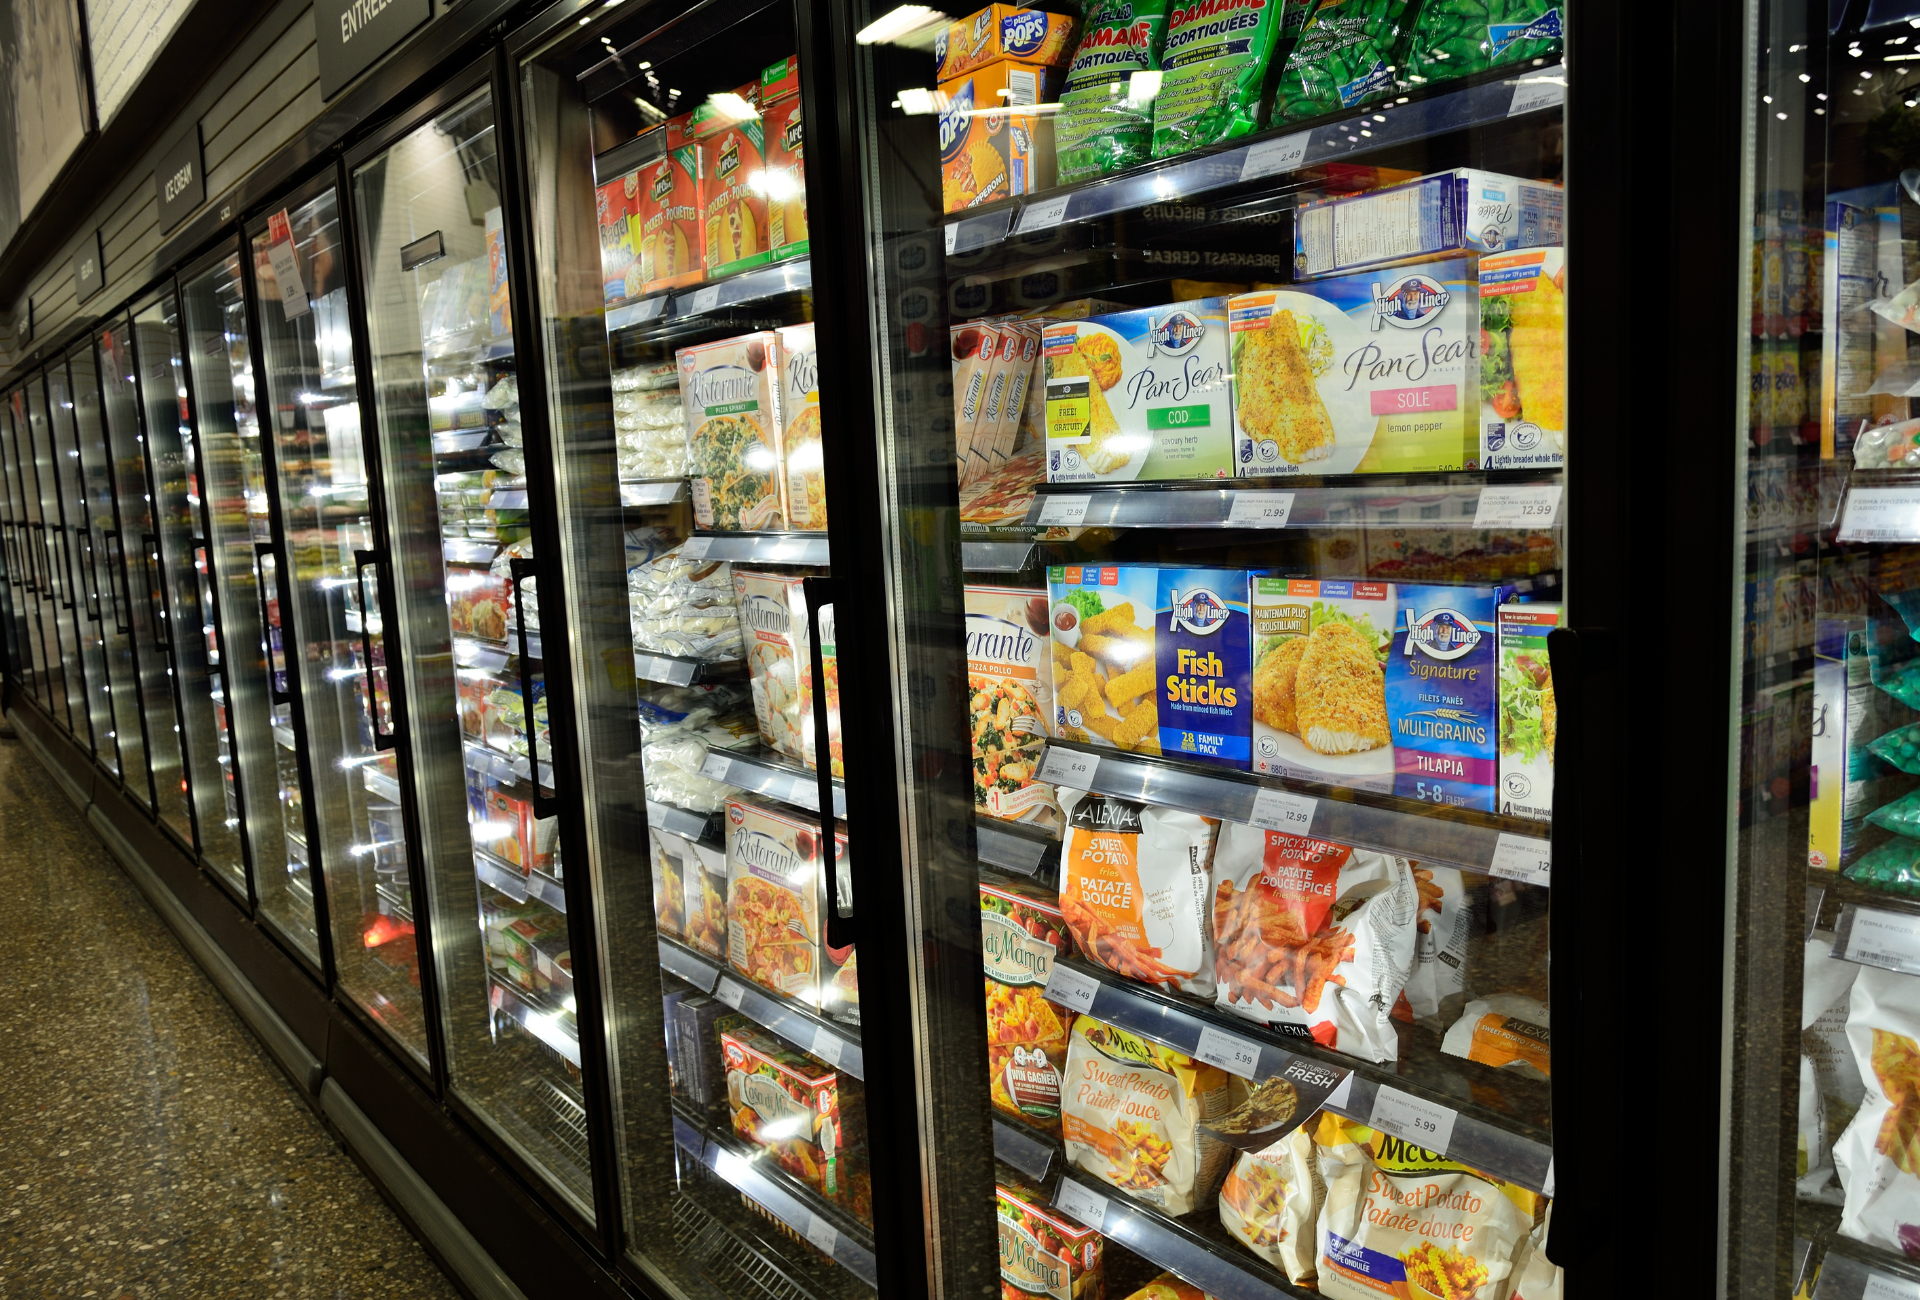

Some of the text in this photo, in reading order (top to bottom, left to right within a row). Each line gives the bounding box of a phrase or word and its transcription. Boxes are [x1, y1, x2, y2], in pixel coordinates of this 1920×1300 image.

[341, 0, 392, 43] ENTRE
[973, 15, 982, 42] 4
[1014, 14, 1032, 26] pizza
[1003, 18, 1044, 54] POPS
[1080, 22, 1152, 53] AMAME
[1165, 12, 1259, 51] ÉCORTIQUÉES
[763, 70, 769, 84] 4
[940, 98, 969, 152] OPS
[1281, 150, 1301, 162] 2.49
[164, 161, 193, 204] ICE CREAM
[967, 173, 1005, 208] PEPPERONI
[707, 190, 730, 218] POCKETS
[643, 205, 696, 236] POCKETS POCHETTES
[1047, 208, 1063, 219] 2.69
[600, 207, 629, 247] Bagel
[1515, 283, 1529, 291] protein
[1378, 292, 1448, 316] High Liner
[1152, 325, 1203, 345] High Liner
[1343, 327, 1478, 392] Pan-Sear
[686, 369, 754, 410] Ristorante
[1127, 355, 1224, 410] Pan-Sear
[963, 371, 982, 421] Ristorante
[986, 372, 1005, 421] Ristorante
[1007, 372, 1025, 421] Ristorante
[1397, 391, 1431, 409] SOLE
[715, 406, 727, 414] PIZZA
[1058, 408, 1078, 417] FREE!
[1168, 410, 1189, 425] COD
[1053, 421, 1083, 433] GRATUIT!
[1387, 421, 1443, 434] lemon pepper
[1162, 435, 1198, 448] savoury herb
[1246, 464, 1299, 476] Lightly breaded whole fillets
[1484, 453, 1551, 470] 4 Lightly breaded whole
[1056, 472, 1086, 482] Lightly whole
[1066, 508, 1084, 517] 12.99
[1263, 508, 1285, 517] 12.99
[1522, 505, 1552, 515] 12.99
[741, 593, 790, 634] Ristorante
[1175, 604, 1228, 621] High Liner
[1254, 607, 1307, 620] MAINTENANT PLUS
[1259, 620, 1302, 632] CROUSTILLANT!
[1410, 624, 1479, 645] High Liner
[966, 627, 1034, 664] orante
[967, 662, 1013, 675] PIZZA POLLO
[1177, 648, 1224, 678] Fish
[1409, 659, 1478, 682] Signature
[1166, 675, 1237, 708] Sticks
[1418, 693, 1464, 706] FILETS PANÉS
[1170, 702, 1233, 716] Made from minced fish fillets
[1181, 731, 1195, 743] 28
[1198, 734, 1224, 747] FAMILY
[1398, 717, 1486, 745] MULTIGRAINS
[1199, 744, 1218, 756] PACK
[1071, 762, 1087, 772] 6.49
[1417, 755, 1465, 777] TILAPIA
[1416, 781, 1465, 807] 5-8 FILETS
[1074, 803, 1138, 827] ALEXIA
[1285, 811, 1308, 823] 12.99
[1513, 802, 1551, 817] Vacuum packed
[1089, 837, 1123, 852] SWEET
[1271, 835, 1344, 857] SPICY SWEET
[1500, 843, 1548, 856] HIGHLINER SELECTS
[1081, 850, 1129, 866] POTATO
[1280, 849, 1323, 863] POTATO
[757, 869, 770, 878] PIZZA
[1099, 867, 1119, 878] fries
[1277, 866, 1314, 880] PATATE
[1080, 877, 1132, 896] PATATE
[1260, 875, 1333, 897] DOUCE EPICÉ
[1082, 891, 1131, 909] DOUCE
[1096, 908, 1116, 920] frites
[1859, 919, 1914, 936] FERMA FROZEN
[1859, 936, 1872, 945] 750
[985, 931, 1048, 976] di Mama
[1440, 953, 1458, 967] ALEXIA
[1075, 989, 1090, 1001] 4.49
[1274, 1024, 1309, 1037] ALEXIA
[1507, 1021, 1550, 1042] ALEXIA
[1208, 1032, 1257, 1053] ALEXIA SWEET POTATO
[1481, 1024, 1550, 1055] SWEET POTATO Patate
[1234, 1052, 1253, 1065] 5.99
[1011, 1069, 1058, 1086] WIN GAGNER
[1284, 1066, 1335, 1089] FRESH
[1292, 1060, 1340, 1079] FEATURED IN
[1083, 1060, 1170, 1101] Sweet Potato
[744, 1075, 773, 1106] Casa di
[1076, 1083, 1119, 1112] Patate
[1119, 1095, 1162, 1122] douce
[1380, 1093, 1443, 1120] ALEXIA SWEET POTATO PUFFS
[1414, 1118, 1437, 1133] 5.99
[1367, 1171, 1482, 1214] Sweet Potato
[1088, 1205, 1103, 1218] 3.79
[1359, 1197, 1475, 1242] Patate douce
[1351, 1249, 1364, 1259] CUT
[1006, 1236, 1061, 1290] Mama
[1344, 1257, 1370, 1274] ONDULÉE
[1871, 1281, 1896, 1295] ALEXIA
